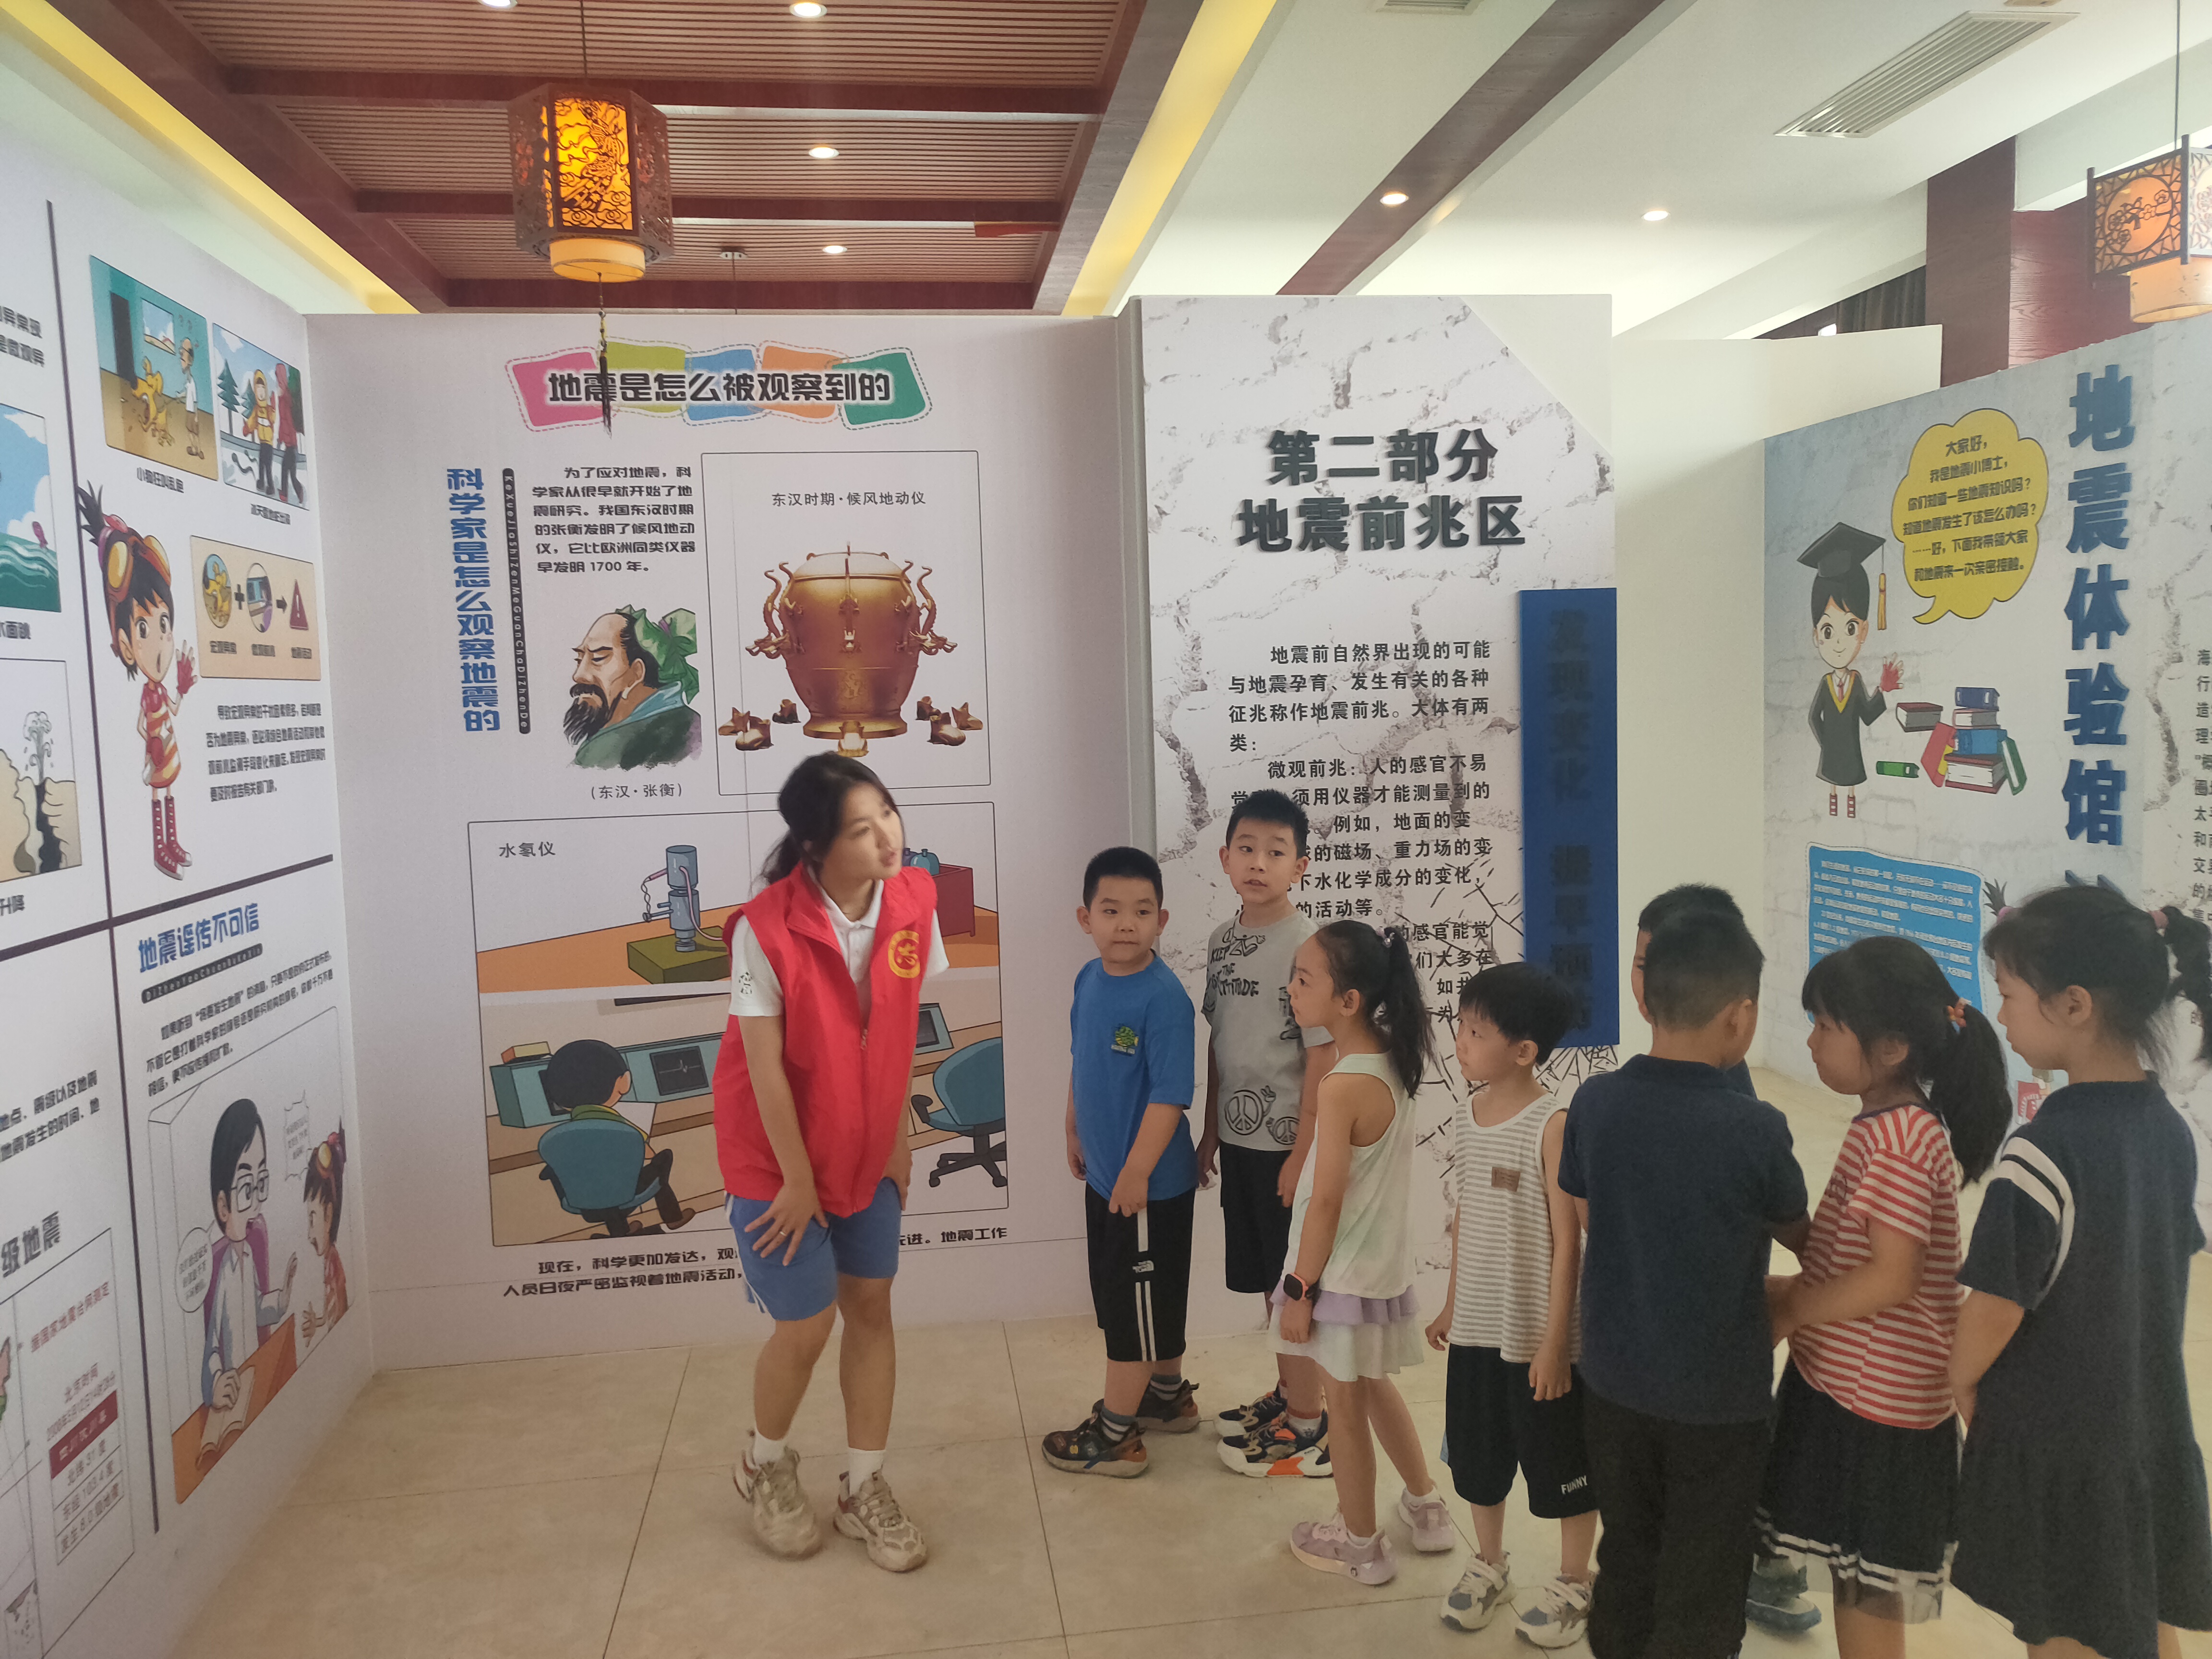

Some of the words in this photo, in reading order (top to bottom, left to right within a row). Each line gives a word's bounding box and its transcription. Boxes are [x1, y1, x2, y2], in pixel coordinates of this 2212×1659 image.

[549, 372, 890, 402] 地震是怎么被观察到的
[1266, 428, 1499, 486] 第二部分
[532, 485, 693, 498] 学家从很早就开始了地
[1237, 494, 1526, 553] 地震前兆区
[446, 468, 501, 732] 科学家是怎么观察地震的
[2061, 363, 2137, 892] 地震体验馆
[1270, 639, 1491, 665] 地震前自然界出现的可能
[1228, 668, 1490, 695] 与地震孕育、发生有关的各种
[1228, 697, 1490, 723] 征兆称作地震前兆。大体有两
[1267, 754, 1487, 779] 微观前兆：人的感官不易
[139, 902, 260, 973] 地震谣传不可信
[1561, 1475, 1588, 1495] FUNNY
